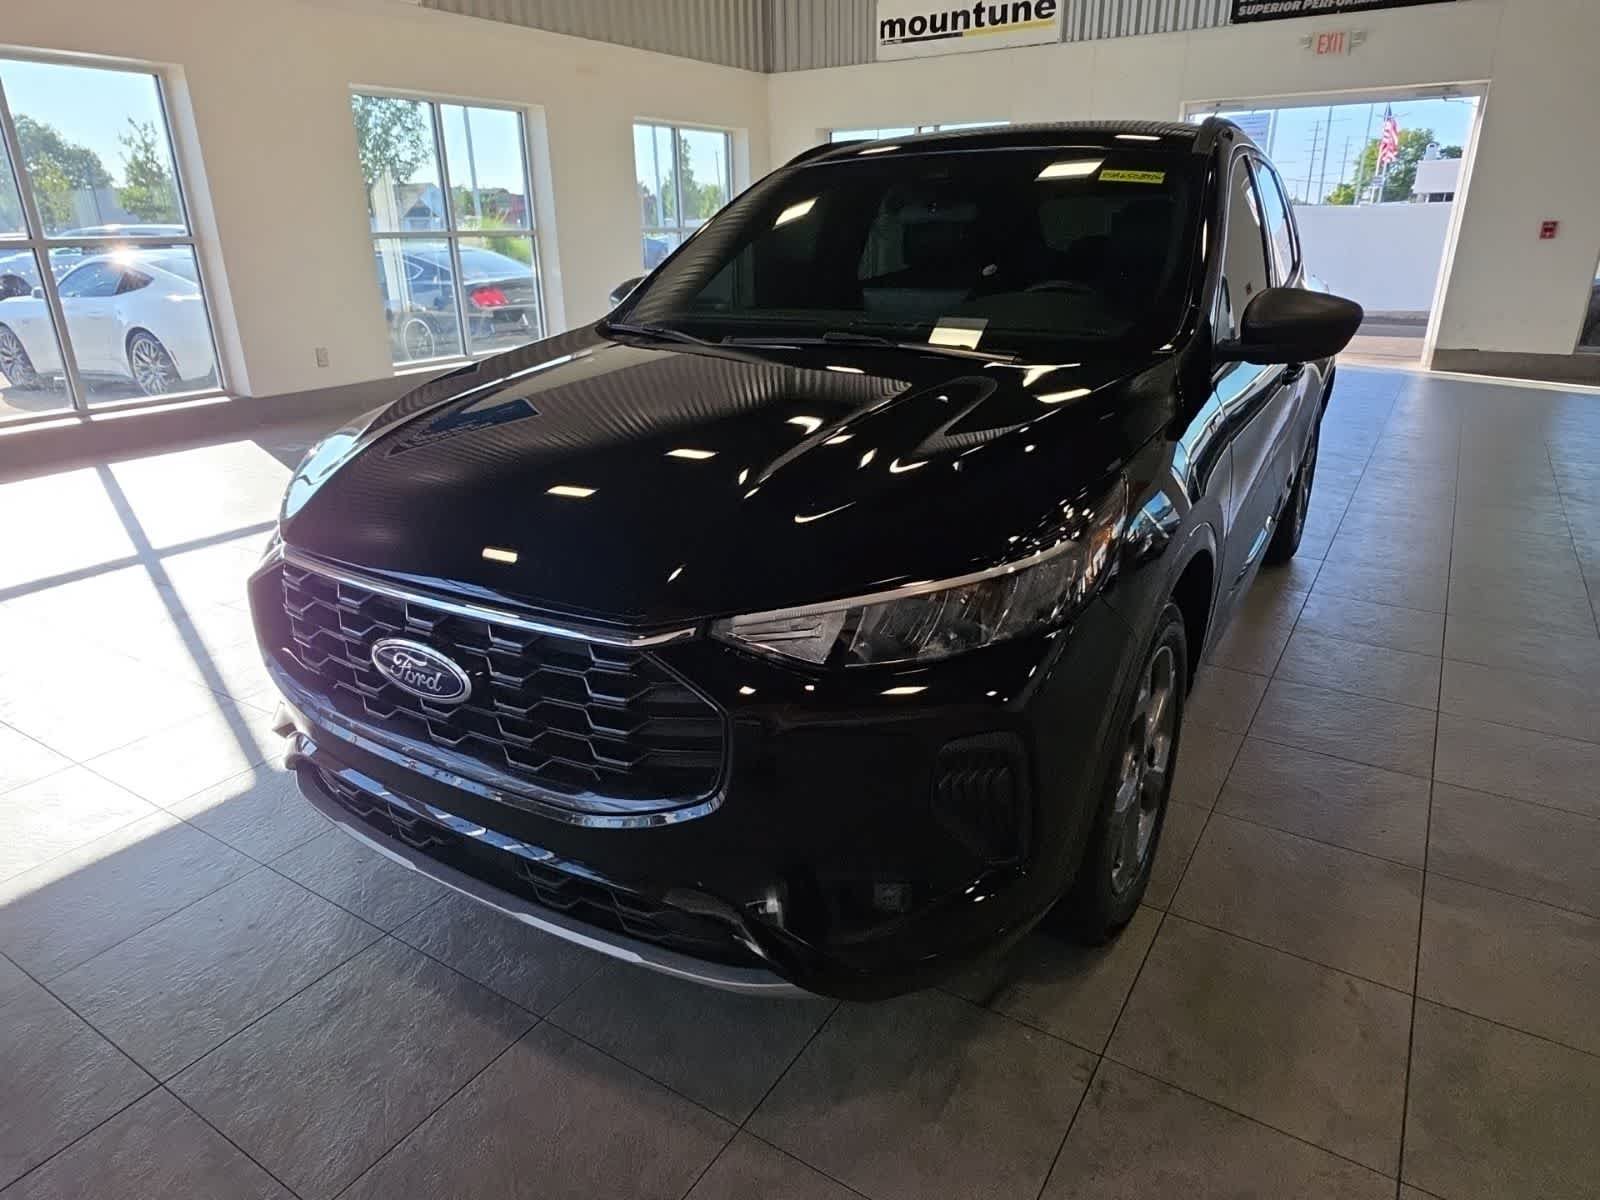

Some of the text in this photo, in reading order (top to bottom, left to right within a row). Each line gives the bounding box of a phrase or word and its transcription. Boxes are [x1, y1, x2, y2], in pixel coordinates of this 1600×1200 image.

[879, 0, 1057, 39] mountune
[1237, 1, 1302, 16] SUPERIOR
[1317, 32, 1346, 55] EXIT
[390, 652, 443, 692] Ford
